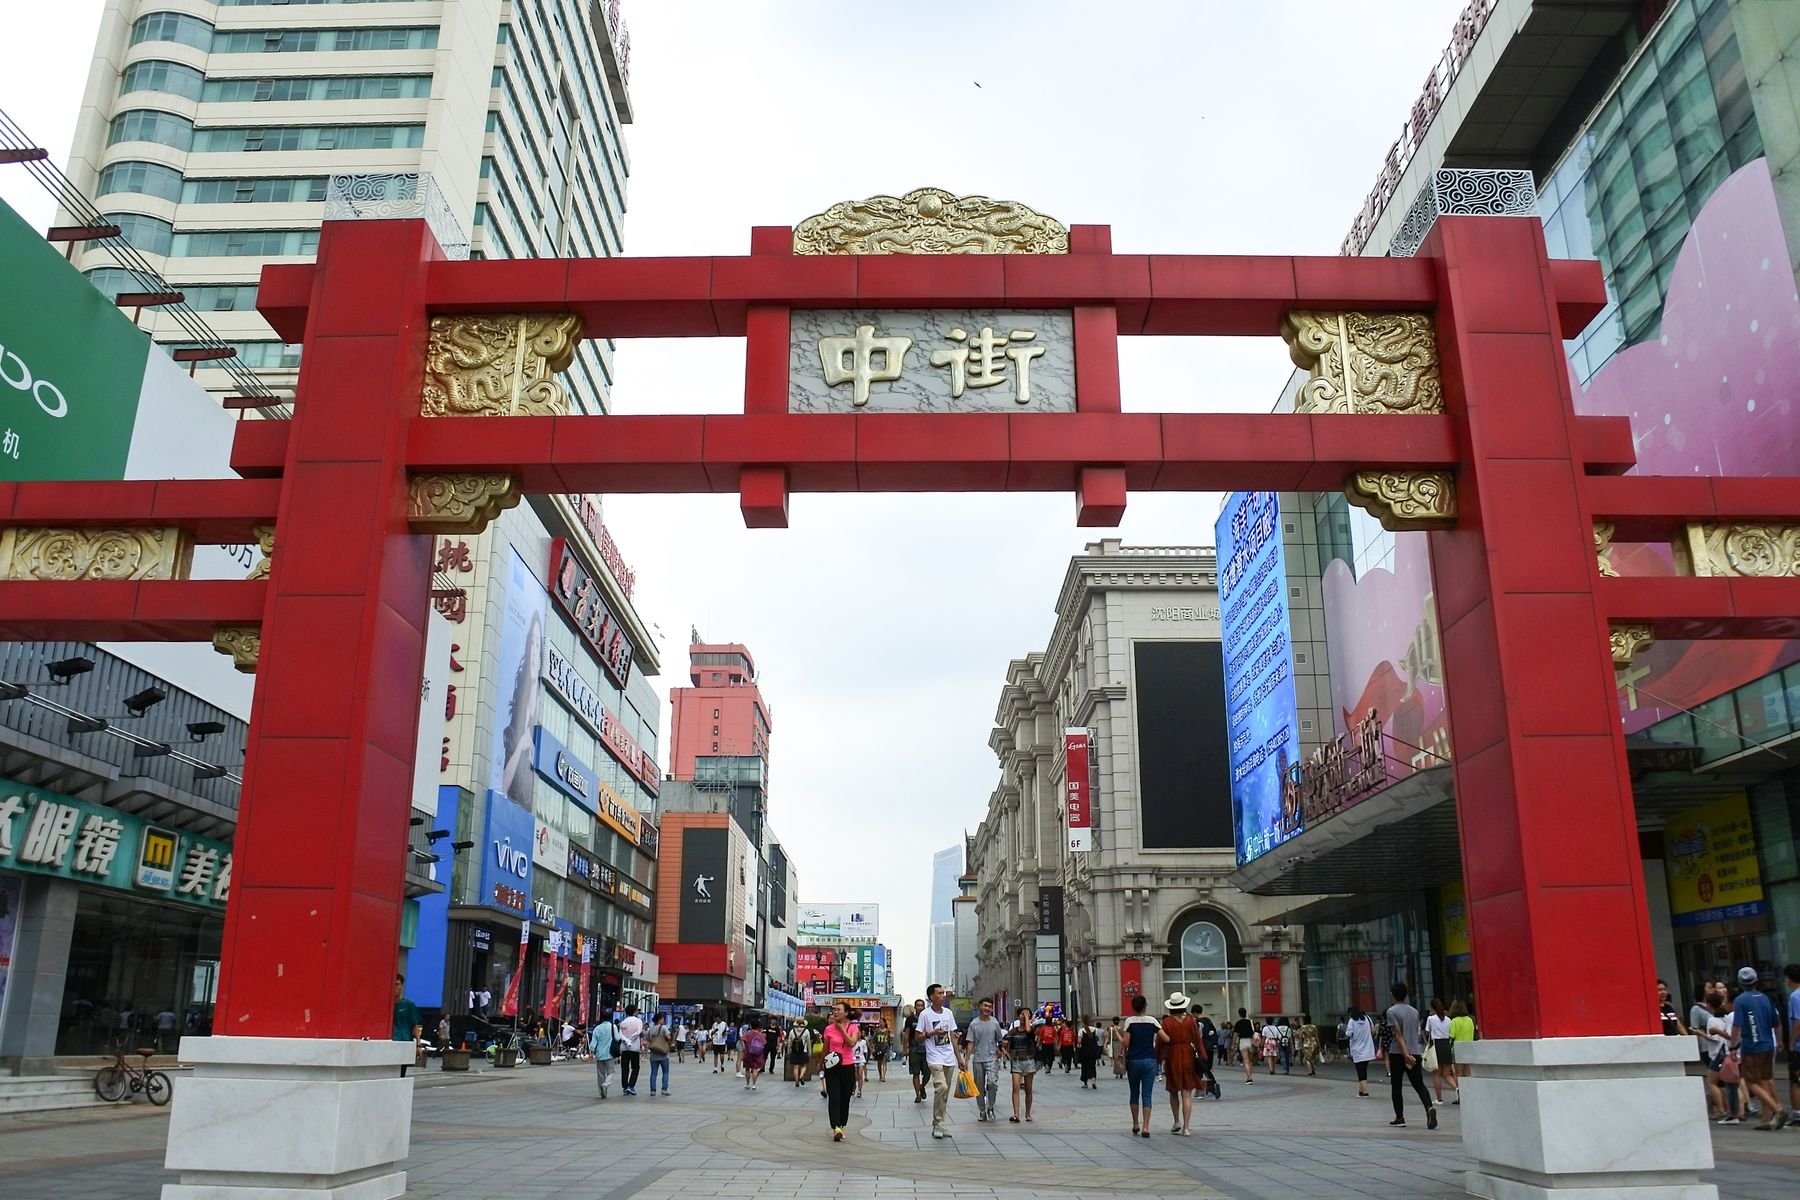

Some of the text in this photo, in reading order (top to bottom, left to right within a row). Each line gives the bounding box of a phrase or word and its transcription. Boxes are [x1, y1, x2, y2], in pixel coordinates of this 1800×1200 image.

[817, 324, 1046, 406] 中街
[494, 836, 528, 879] vivo
[1070, 839, 1081, 849] 6F
